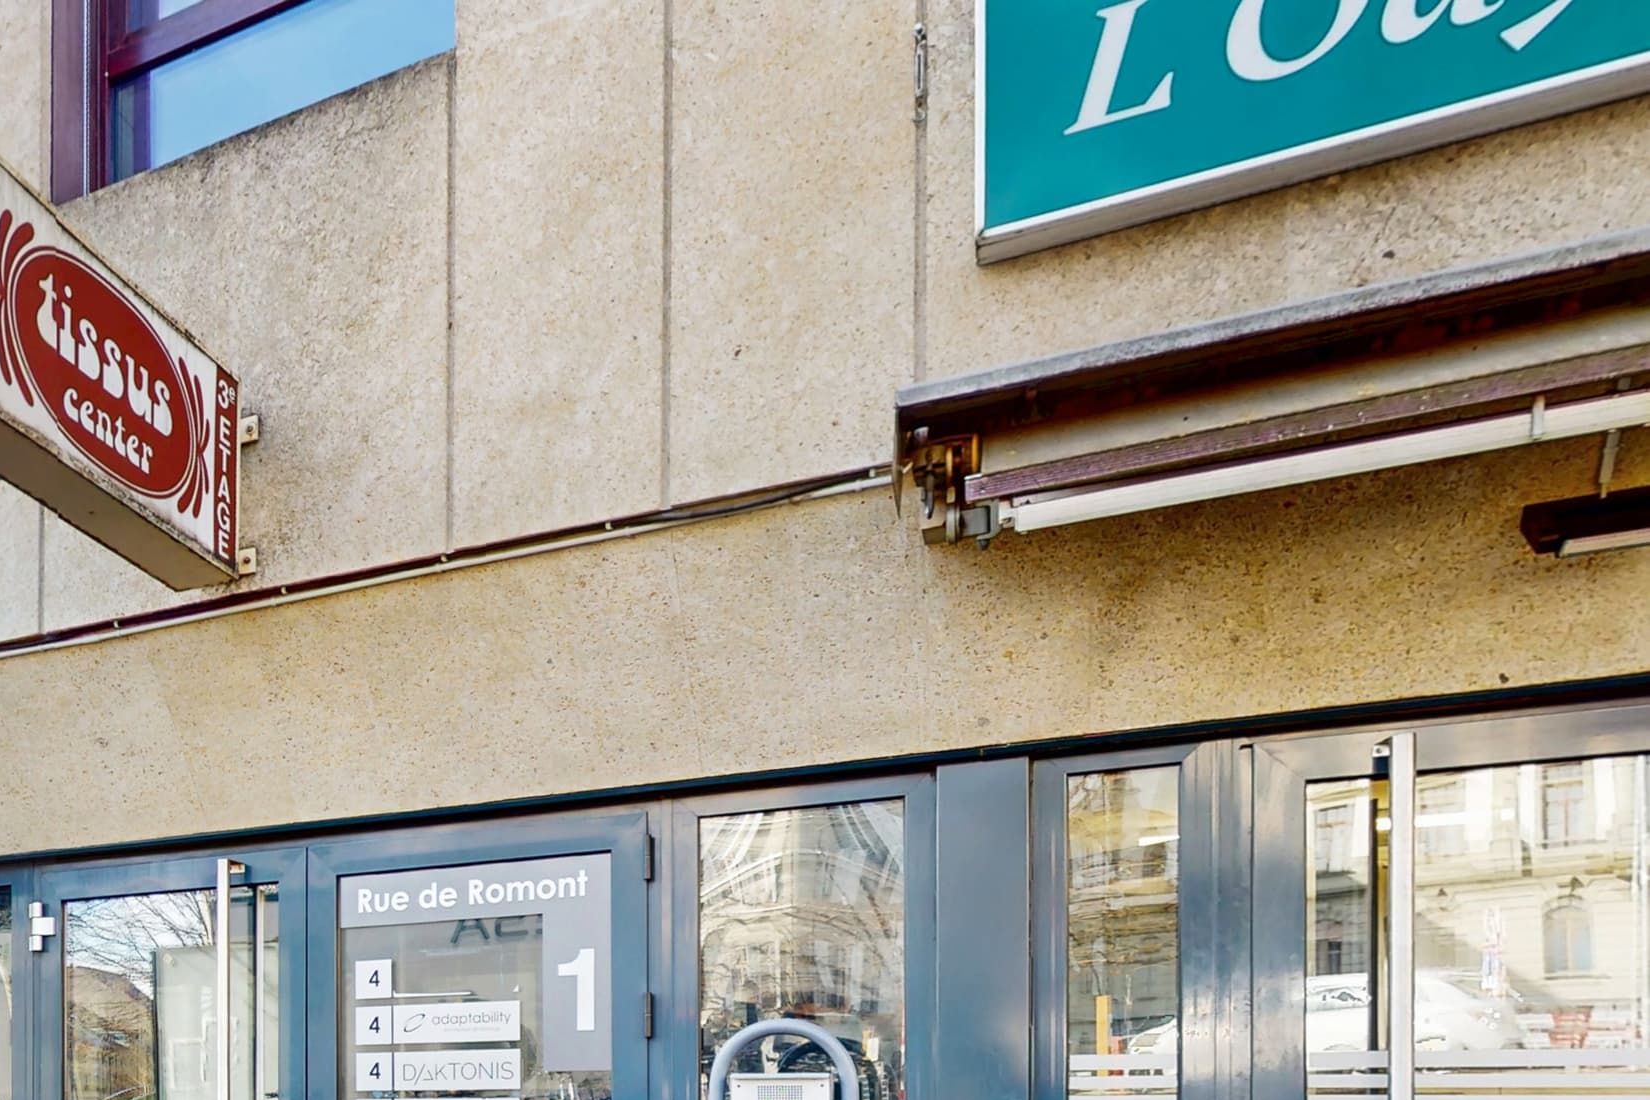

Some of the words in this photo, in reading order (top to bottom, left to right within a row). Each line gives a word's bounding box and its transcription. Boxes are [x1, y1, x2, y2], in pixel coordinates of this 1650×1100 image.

[36, 273, 173, 437] tissus
[63, 388, 154, 474] center
[217, 415, 231, 560] ETAGE
[357, 889, 409, 913] Rue
[418, 882, 458, 909] de
[468, 869, 589, 906] Romont
[368, 969, 380, 987] 4
[557, 948, 595, 1031] 1
[369, 1016, 381, 1033] 4
[431, 1011, 511, 1026] adaptability
[369, 1062, 381, 1079] 4
